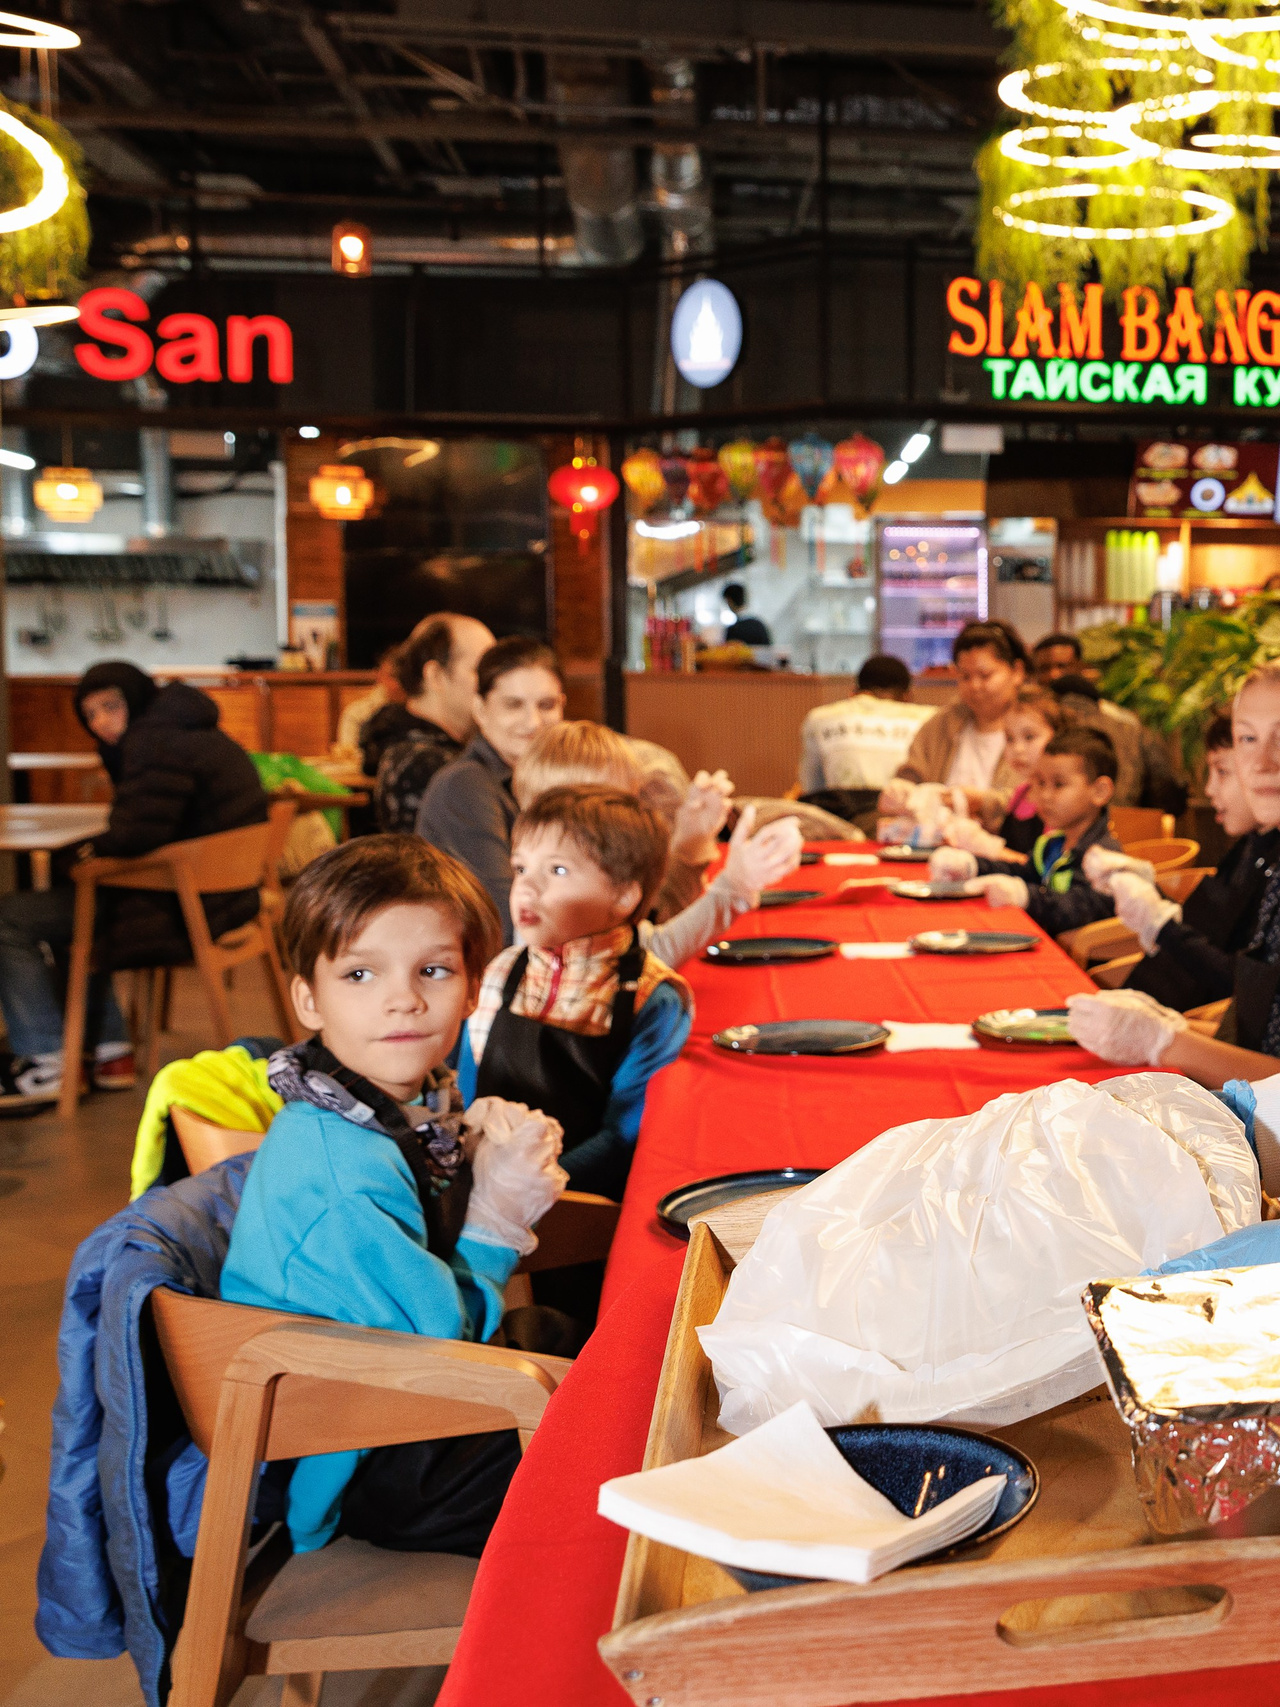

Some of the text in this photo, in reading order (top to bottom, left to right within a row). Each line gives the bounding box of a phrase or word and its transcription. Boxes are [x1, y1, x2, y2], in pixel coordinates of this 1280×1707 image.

[73, 286, 294, 384] San
[946, 276, 1105, 360] SIAM
[982, 356, 1208, 405] ТАЙСКАЯ
